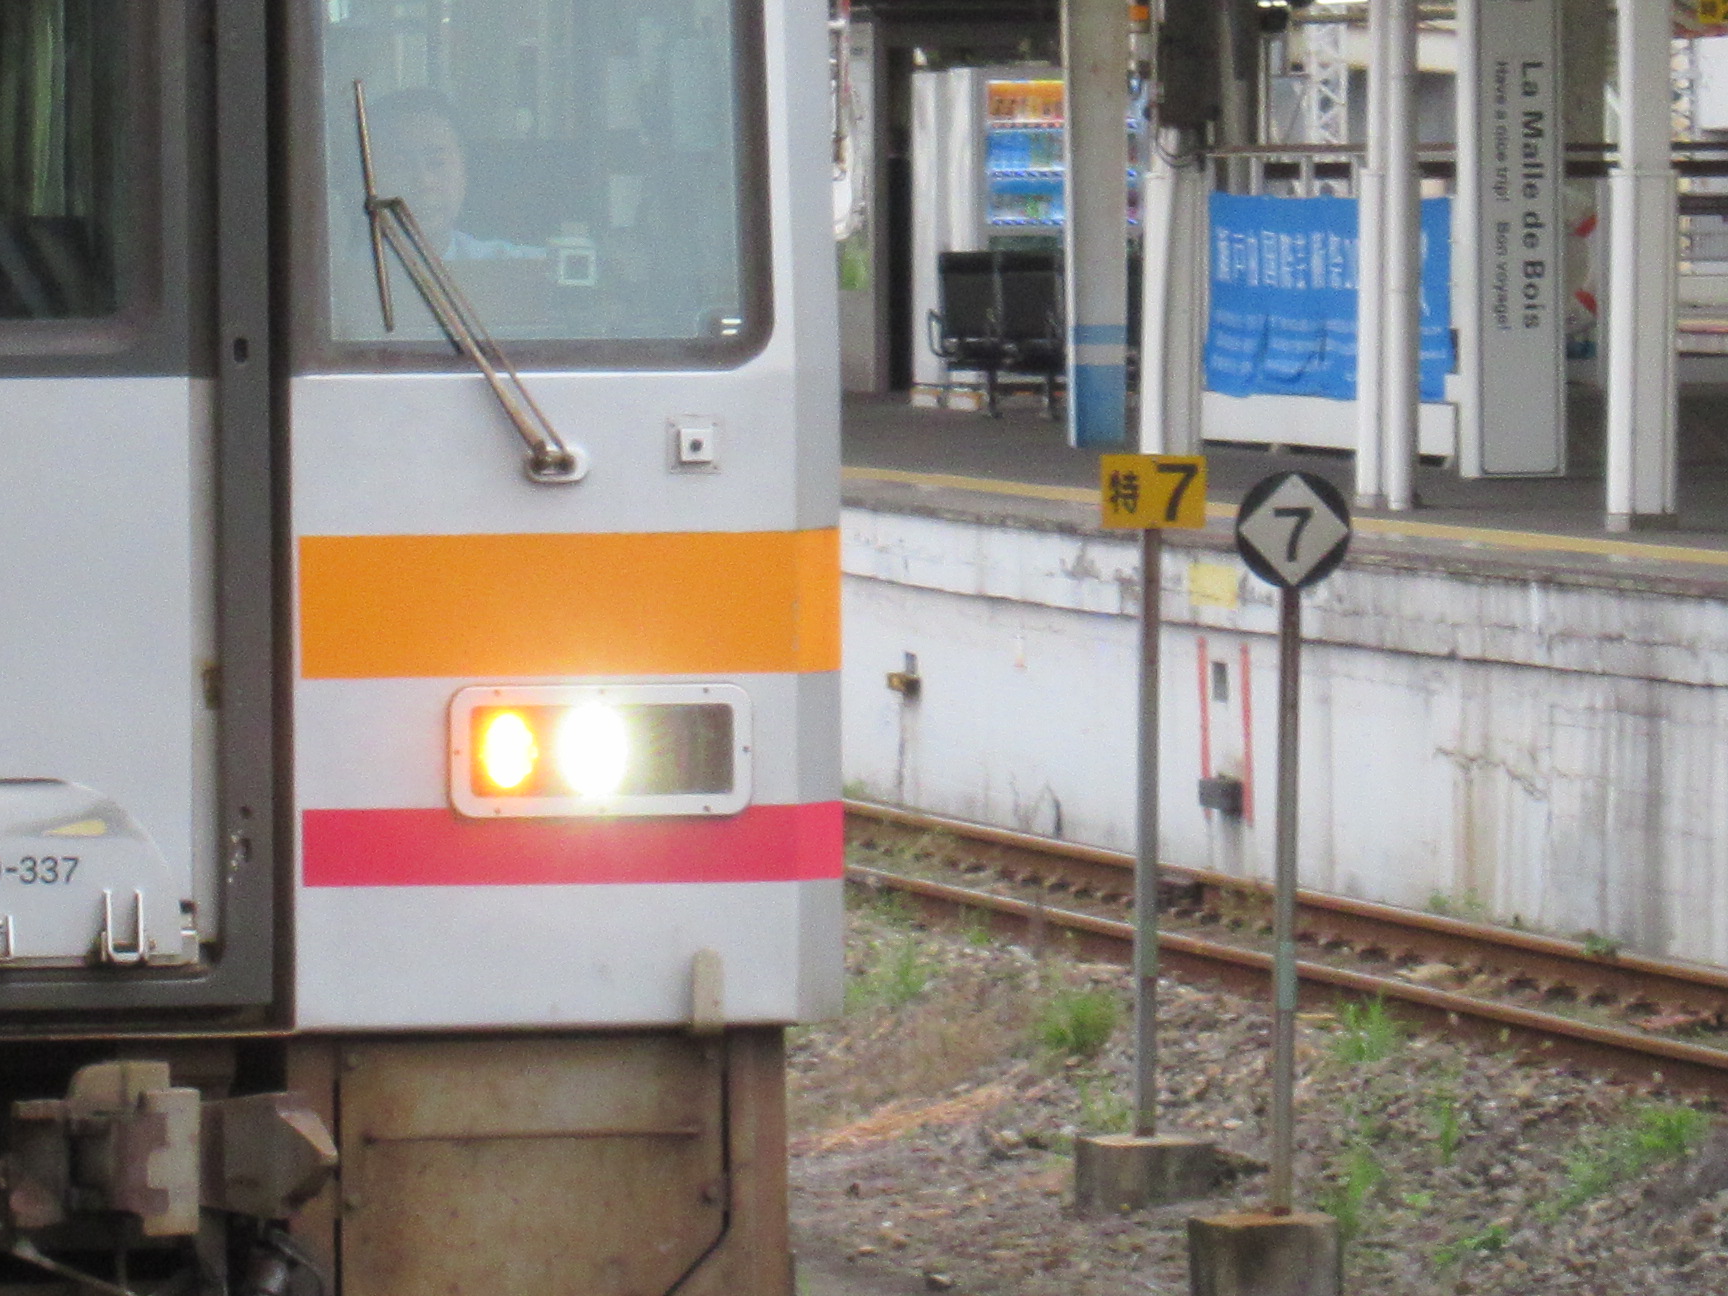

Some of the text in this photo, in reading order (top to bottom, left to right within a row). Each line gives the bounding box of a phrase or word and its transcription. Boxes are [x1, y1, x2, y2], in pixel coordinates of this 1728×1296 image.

[1495, 60, 1509, 105] Have
[1494, 124, 1508, 162] nice
[1522, 60, 1545, 329] La Malle de Bois
[1496, 221, 1510, 256] Bon
[1273, 507, 1312, 562] 7
